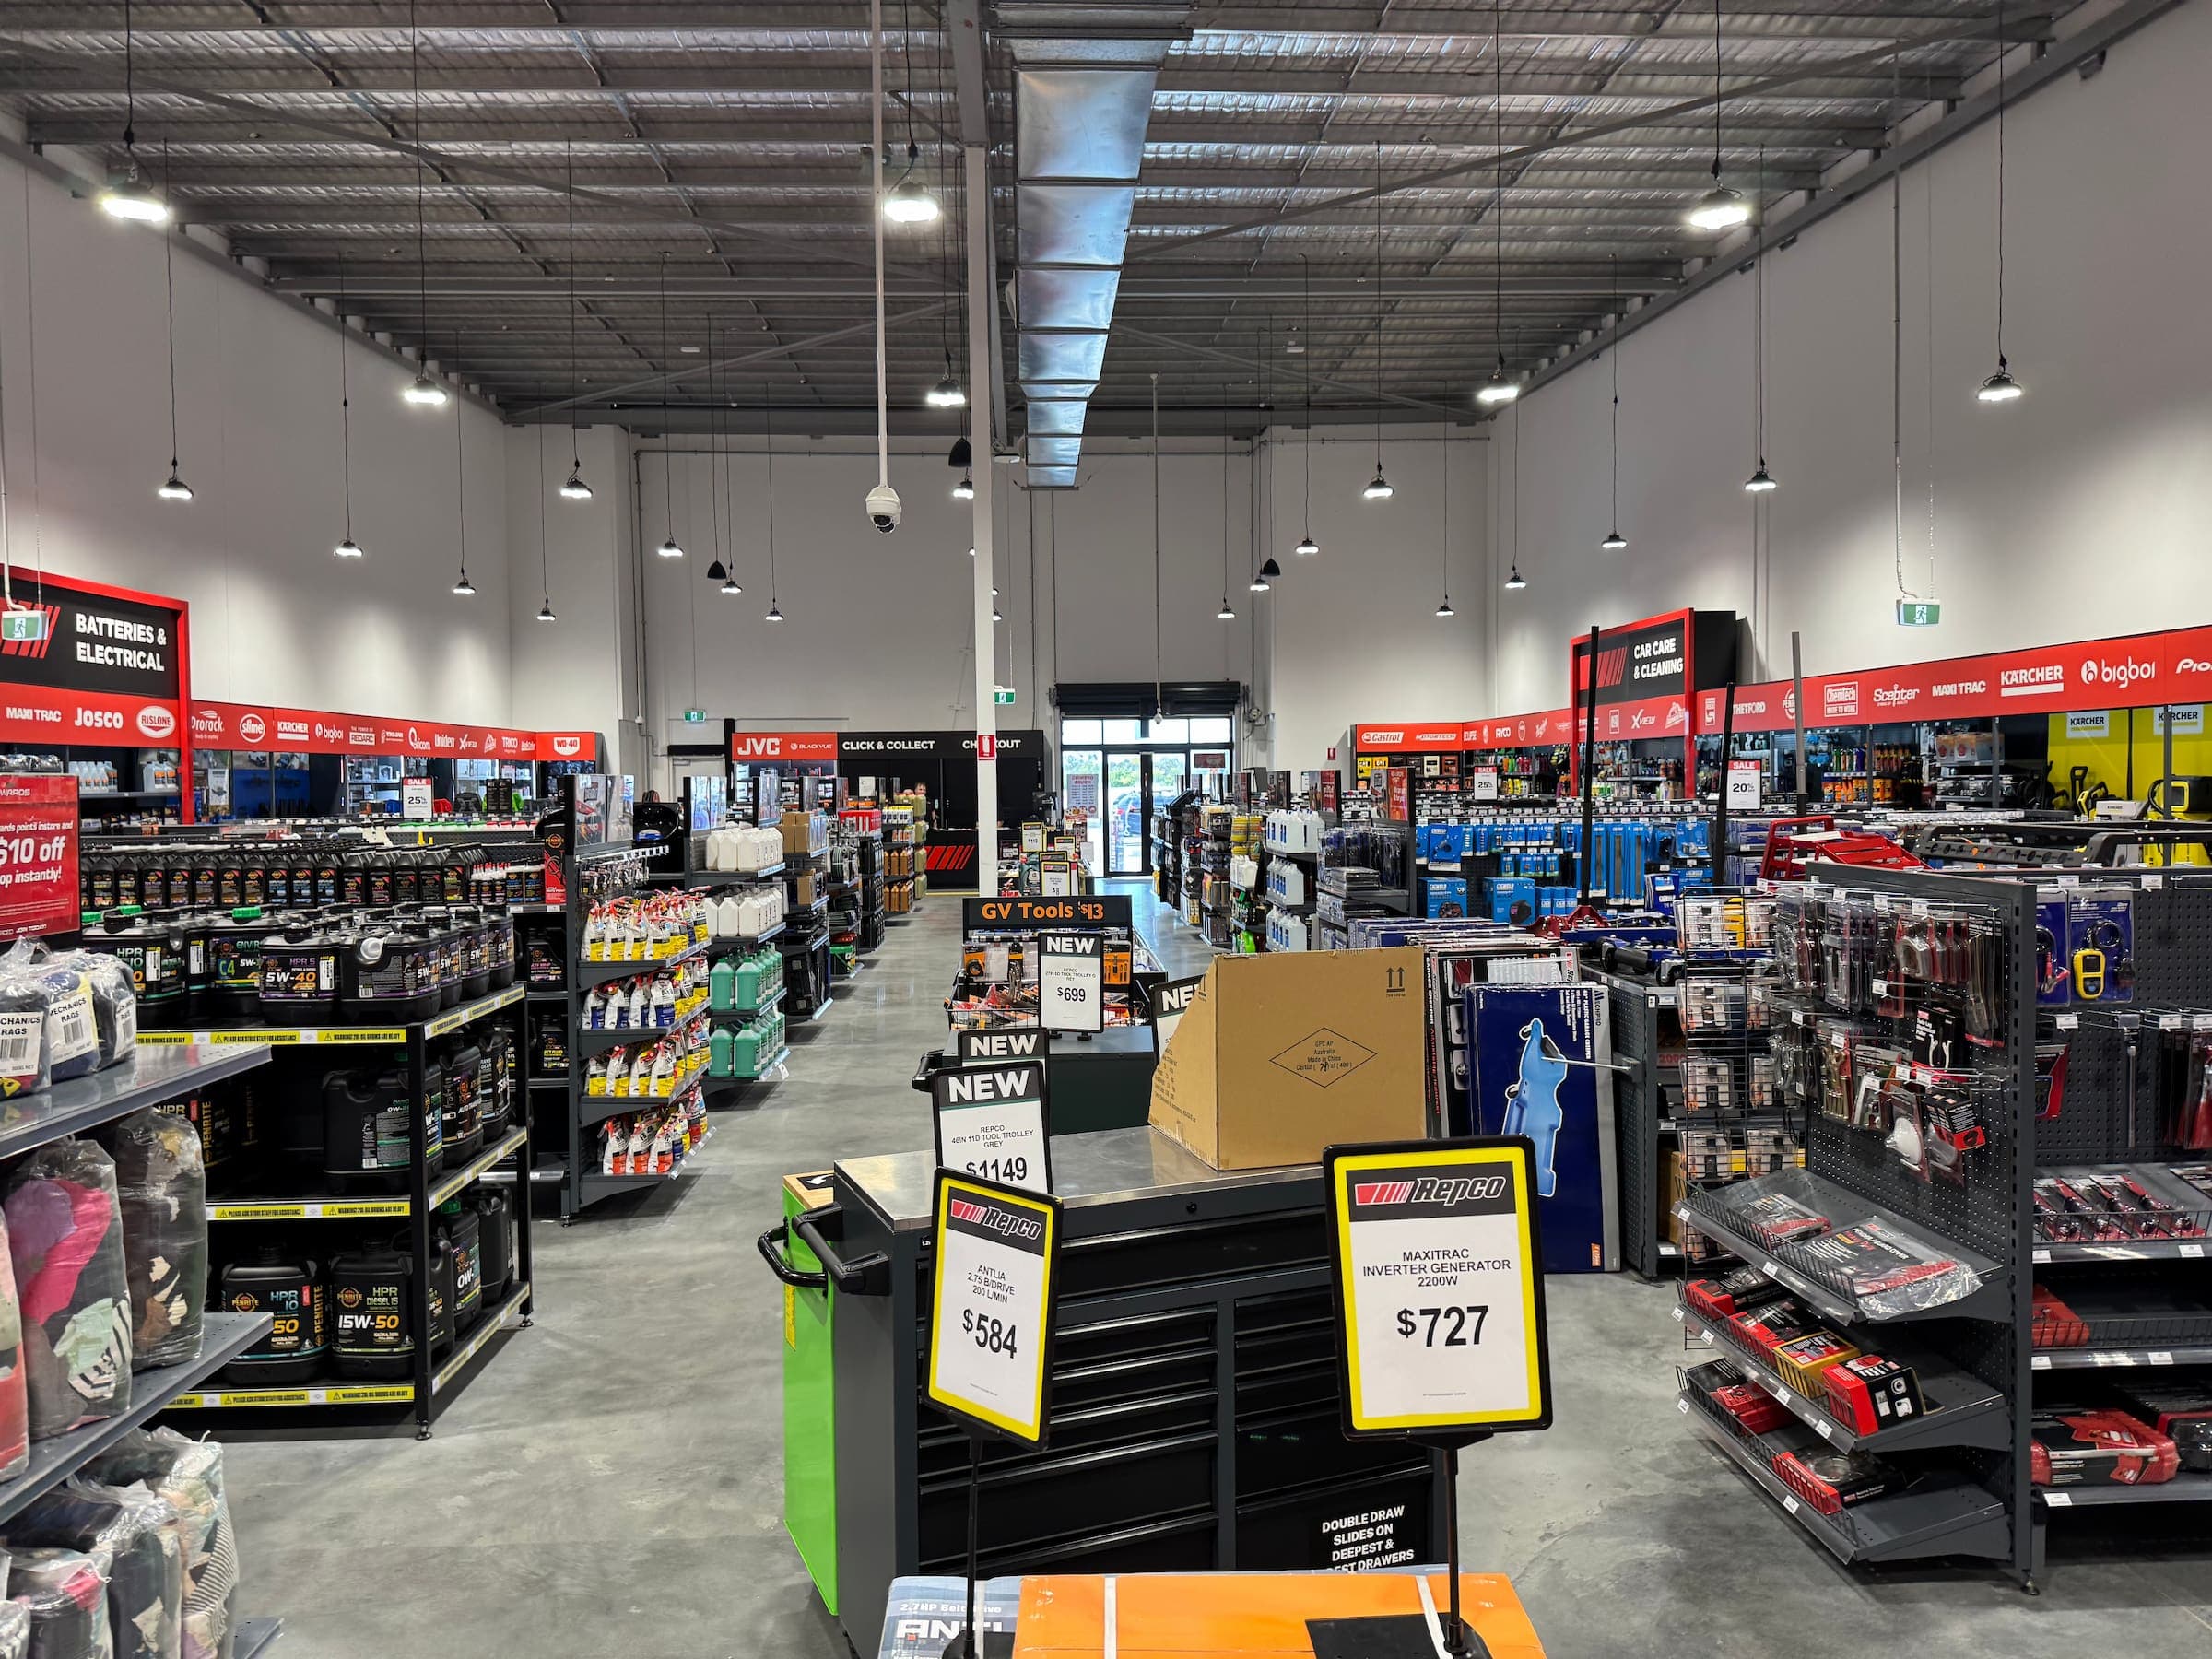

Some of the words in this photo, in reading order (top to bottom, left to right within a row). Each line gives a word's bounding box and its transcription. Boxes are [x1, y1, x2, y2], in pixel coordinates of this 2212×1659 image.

[76, 612, 154, 644] BATTERIES
[157, 627, 167, 645] &
[76, 641, 165, 672] ELECTRICAL
[1634, 643, 1652, 659] CAR
[1653, 637, 1677, 655] CARE
[1634, 665, 1641, 679] &
[1641, 657, 1684, 678] CLEANING
[2000, 665, 2064, 686] KÄRCHER
[1873, 683, 1921, 707] Scepter
[1932, 682, 1957, 697] MAXI
[1959, 680, 1987, 694] TRAC
[6, 706, 33, 720] MAXI
[34, 708, 62, 723] TRAC
[74, 707, 124, 729] JOSCO
[141, 713, 171, 726] RISLONE
[1733, 702, 1766, 715] THETFORD
[2158, 711, 2198, 722] KRCHER
[241, 718, 264, 735] slime
[1495, 727, 1511, 738] RYCO
[737, 737, 781, 756] JVC
[842, 740, 876, 750] CLICK
[877, 740, 885, 750] &
[886, 740, 936, 750] COLLECT
[962, 738, 1022, 749] CHOUT
[1371, 732, 1401, 743] Castrol
[39, 835, 66, 862] off
[15, 865, 62, 884] instantly!
[982, 902, 1013, 920] GV
[1018, 901, 1074, 919] Tools
[116, 947, 144, 958] HPR
[1046, 936, 1096, 954] NEW
[289, 958, 307, 966] HPR
[265, 971, 317, 982] 5W-40
[1057, 986, 1086, 1003] $699
[1161, 983, 1200, 1012] NE
[61, 1010, 80, 1023] RAGS
[1, 1028, 28, 1036] RAGS
[971, 1034, 1038, 1057] NEW
[948, 1069, 1030, 1103] NEW
[202, 1100, 213, 1149] PENRITE
[982, 1133, 1001, 1141] TOOL
[1003, 1130, 1034, 1139] TROLLEY
[983, 1140, 1004, 1148] GREY
[966, 1156, 1028, 1181] $1149
[1410, 1175, 1507, 1206] Repco
[982, 1206, 1042, 1241] Repco
[1402, 1247, 1470, 1263] MAXITRAC
[977, 1265, 1006, 1281] ANTLIA
[1362, 1263, 1428, 1277] INVERTER
[1430, 1258, 1512, 1275] GENERATOR
[967, 1272, 984, 1287] 2.75
[984, 1277, 1016, 1296] B/DRIVE
[1418, 1275, 1459, 1288] 2200W
[270, 1290, 299, 1301] HPR
[366, 1297, 390, 1305] DIESEL
[372, 1287, 398, 1297] HPR
[972, 1285, 986, 1299] 200
[986, 1288, 1008, 1304] L/MIN
[313, 1285, 324, 1334] PENRITE
[338, 1314, 400, 1329] 15W-50
[1396, 1305, 1489, 1347] $727
[962, 1308, 1018, 1359] $584
[1322, 1512, 1369, 1533] DOUBLE
[1370, 1505, 1405, 1523] DRAW
[1333, 1526, 1375, 1546] SLIDES
[1375, 1523, 1394, 1536] ON
[1332, 1542, 1384, 1562] DEEPEST
[1384, 1538, 1394, 1550] &
[1357, 1548, 1415, 1571] DRAWERS
[940, 1604, 966, 1613] Belt
